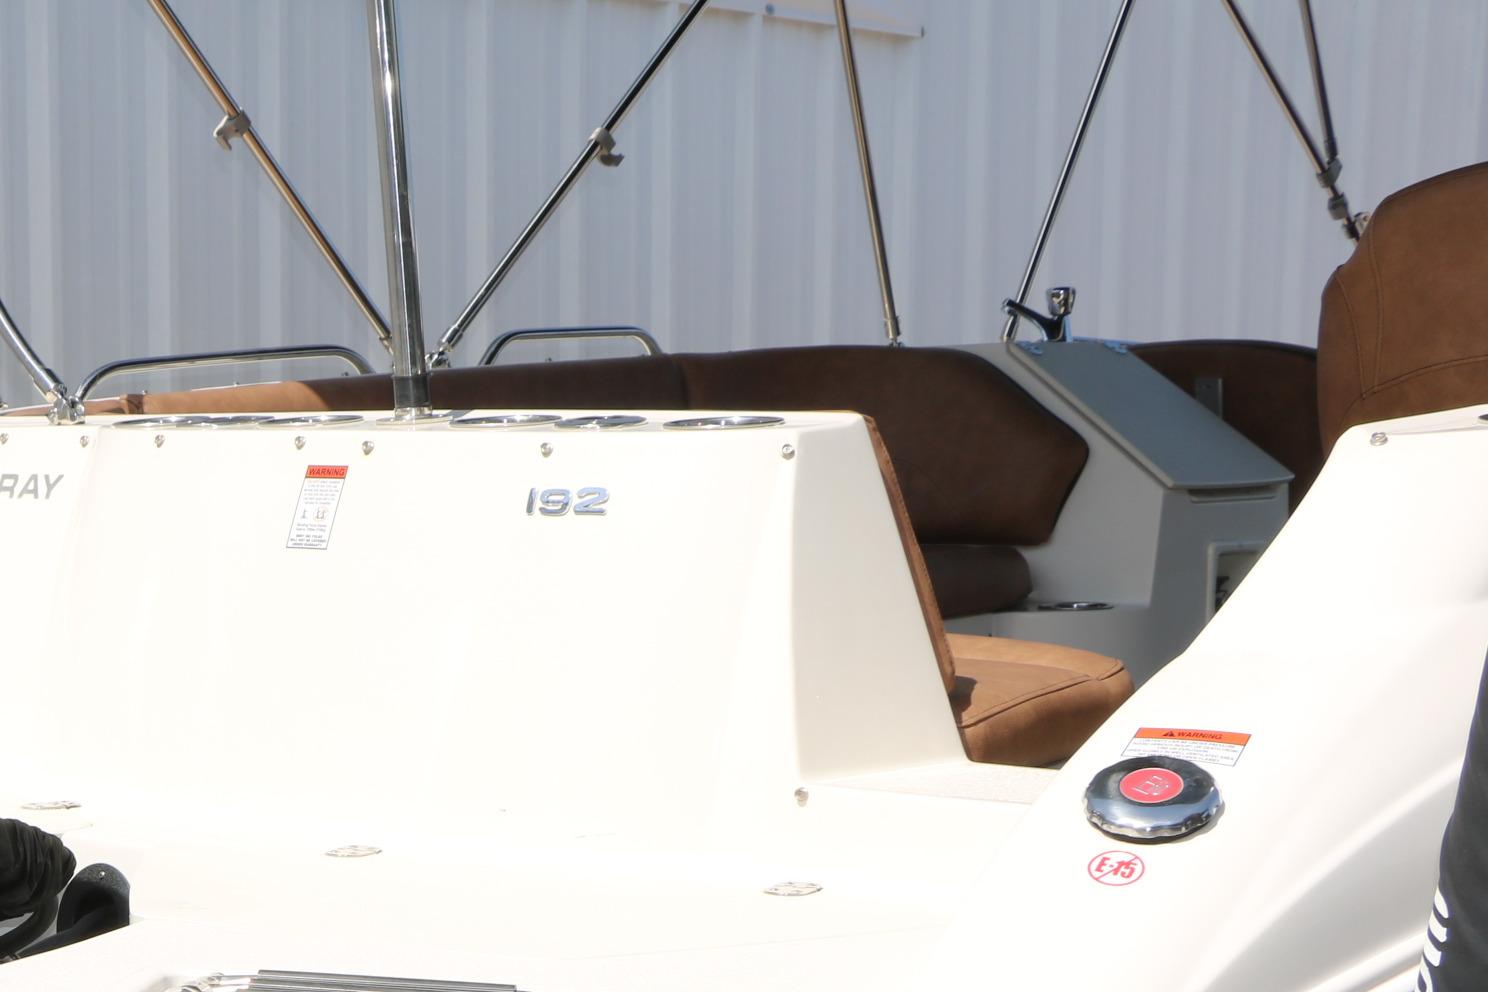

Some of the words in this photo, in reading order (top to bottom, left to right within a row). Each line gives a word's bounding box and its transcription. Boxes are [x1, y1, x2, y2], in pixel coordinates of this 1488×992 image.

[309, 467, 346, 477] WARNING
[525, 486, 610, 517] 192
[1177, 731, 1224, 741] WARNING
[1094, 856, 1139, 879] E-15
